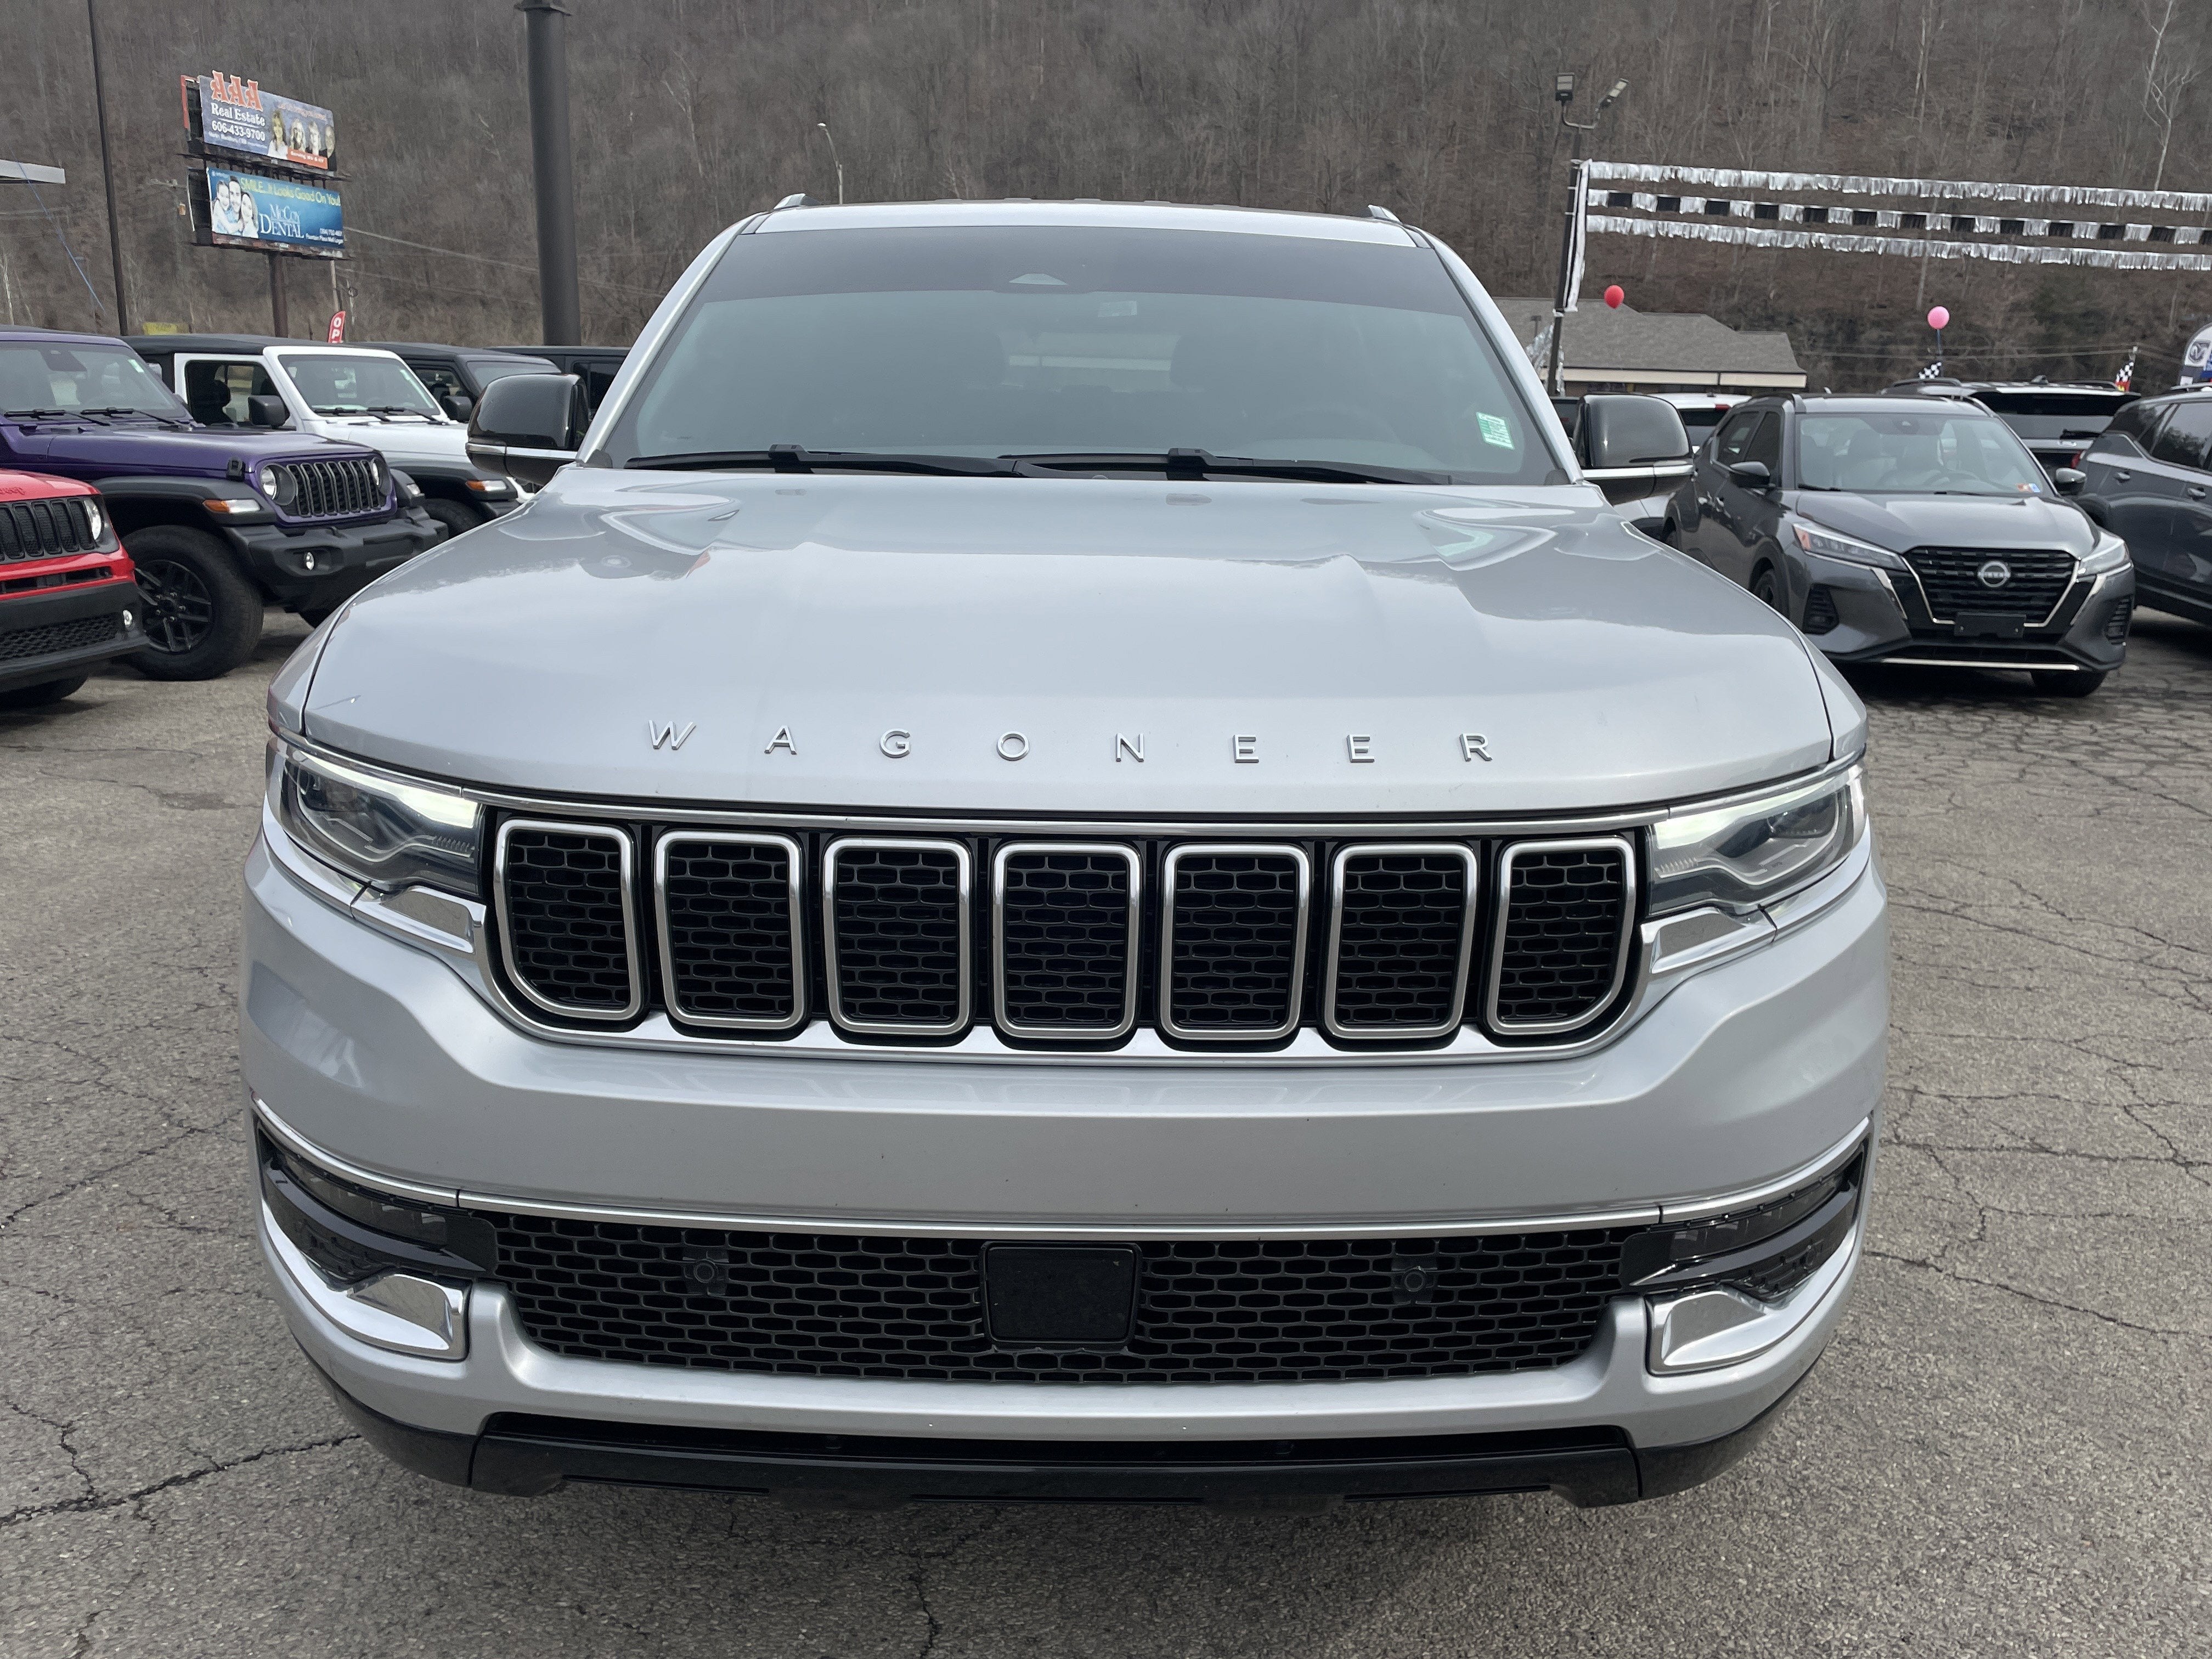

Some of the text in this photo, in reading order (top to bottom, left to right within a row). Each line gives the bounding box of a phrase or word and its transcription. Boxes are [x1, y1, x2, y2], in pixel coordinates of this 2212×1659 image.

[210, 70, 263, 112] AAA
[211, 102, 233, 119] Real
[234, 108, 266, 126] Estate
[212, 120, 266, 142] 606-433-9700
[295, 187, 315, 202] Good
[315, 191, 327, 204] On
[259, 212, 304, 239] DENTAL
[331, 317, 342, 343] OP
[647, 719, 1493, 763] WAGONEER
